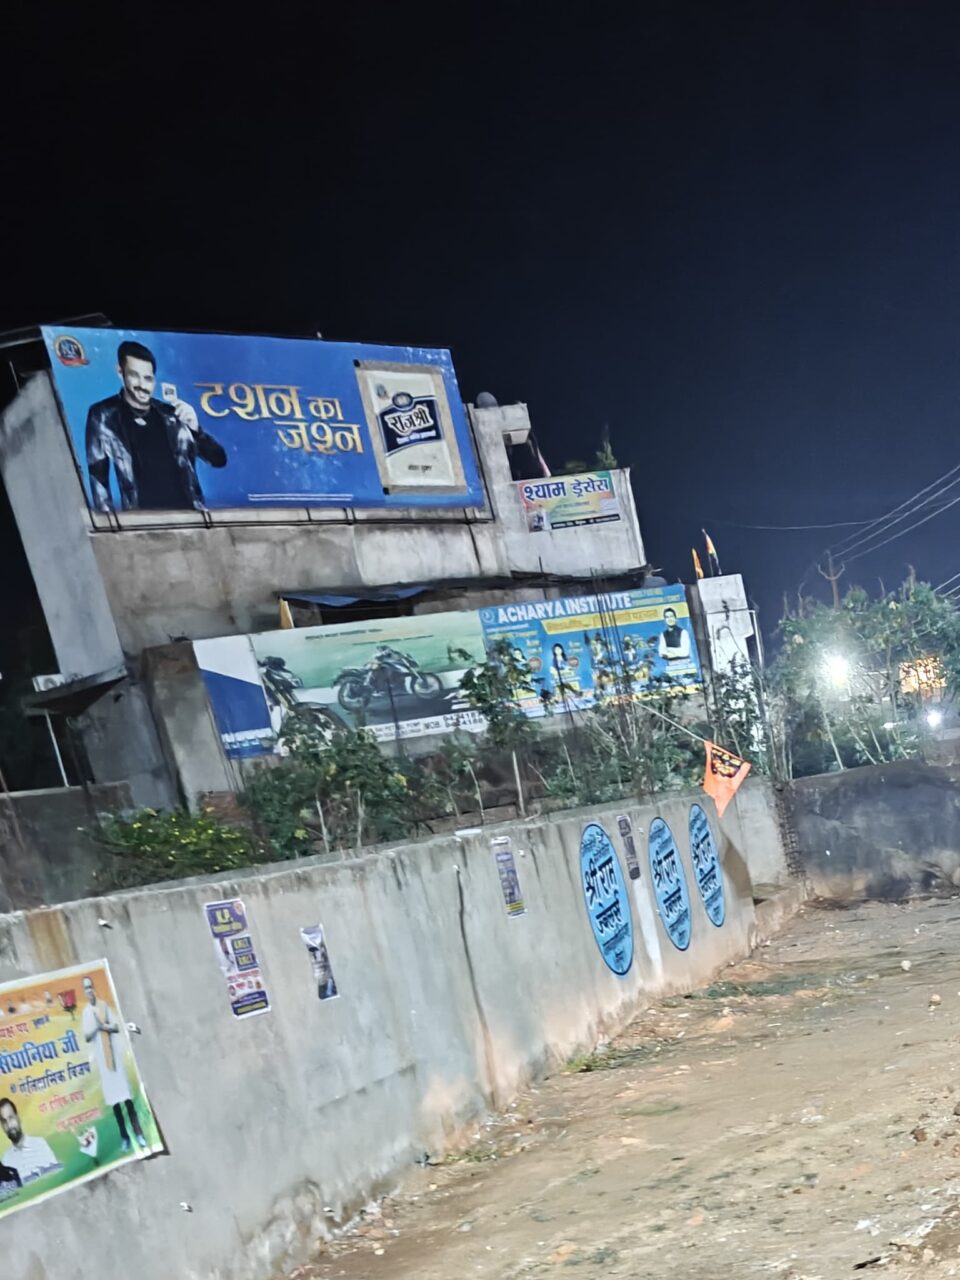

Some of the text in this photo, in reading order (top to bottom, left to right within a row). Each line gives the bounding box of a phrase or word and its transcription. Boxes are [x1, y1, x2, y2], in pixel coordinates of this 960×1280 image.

[193, 383, 344, 421] टशन का
[388, 405, 431, 433] राजश्री
[273, 420, 363, 454] जश्न
[523, 477, 609, 501] श्याम ड्रेसेस
[498, 600, 566, 624] ACHARYA
[566, 592, 633, 615] INSTITUTE
